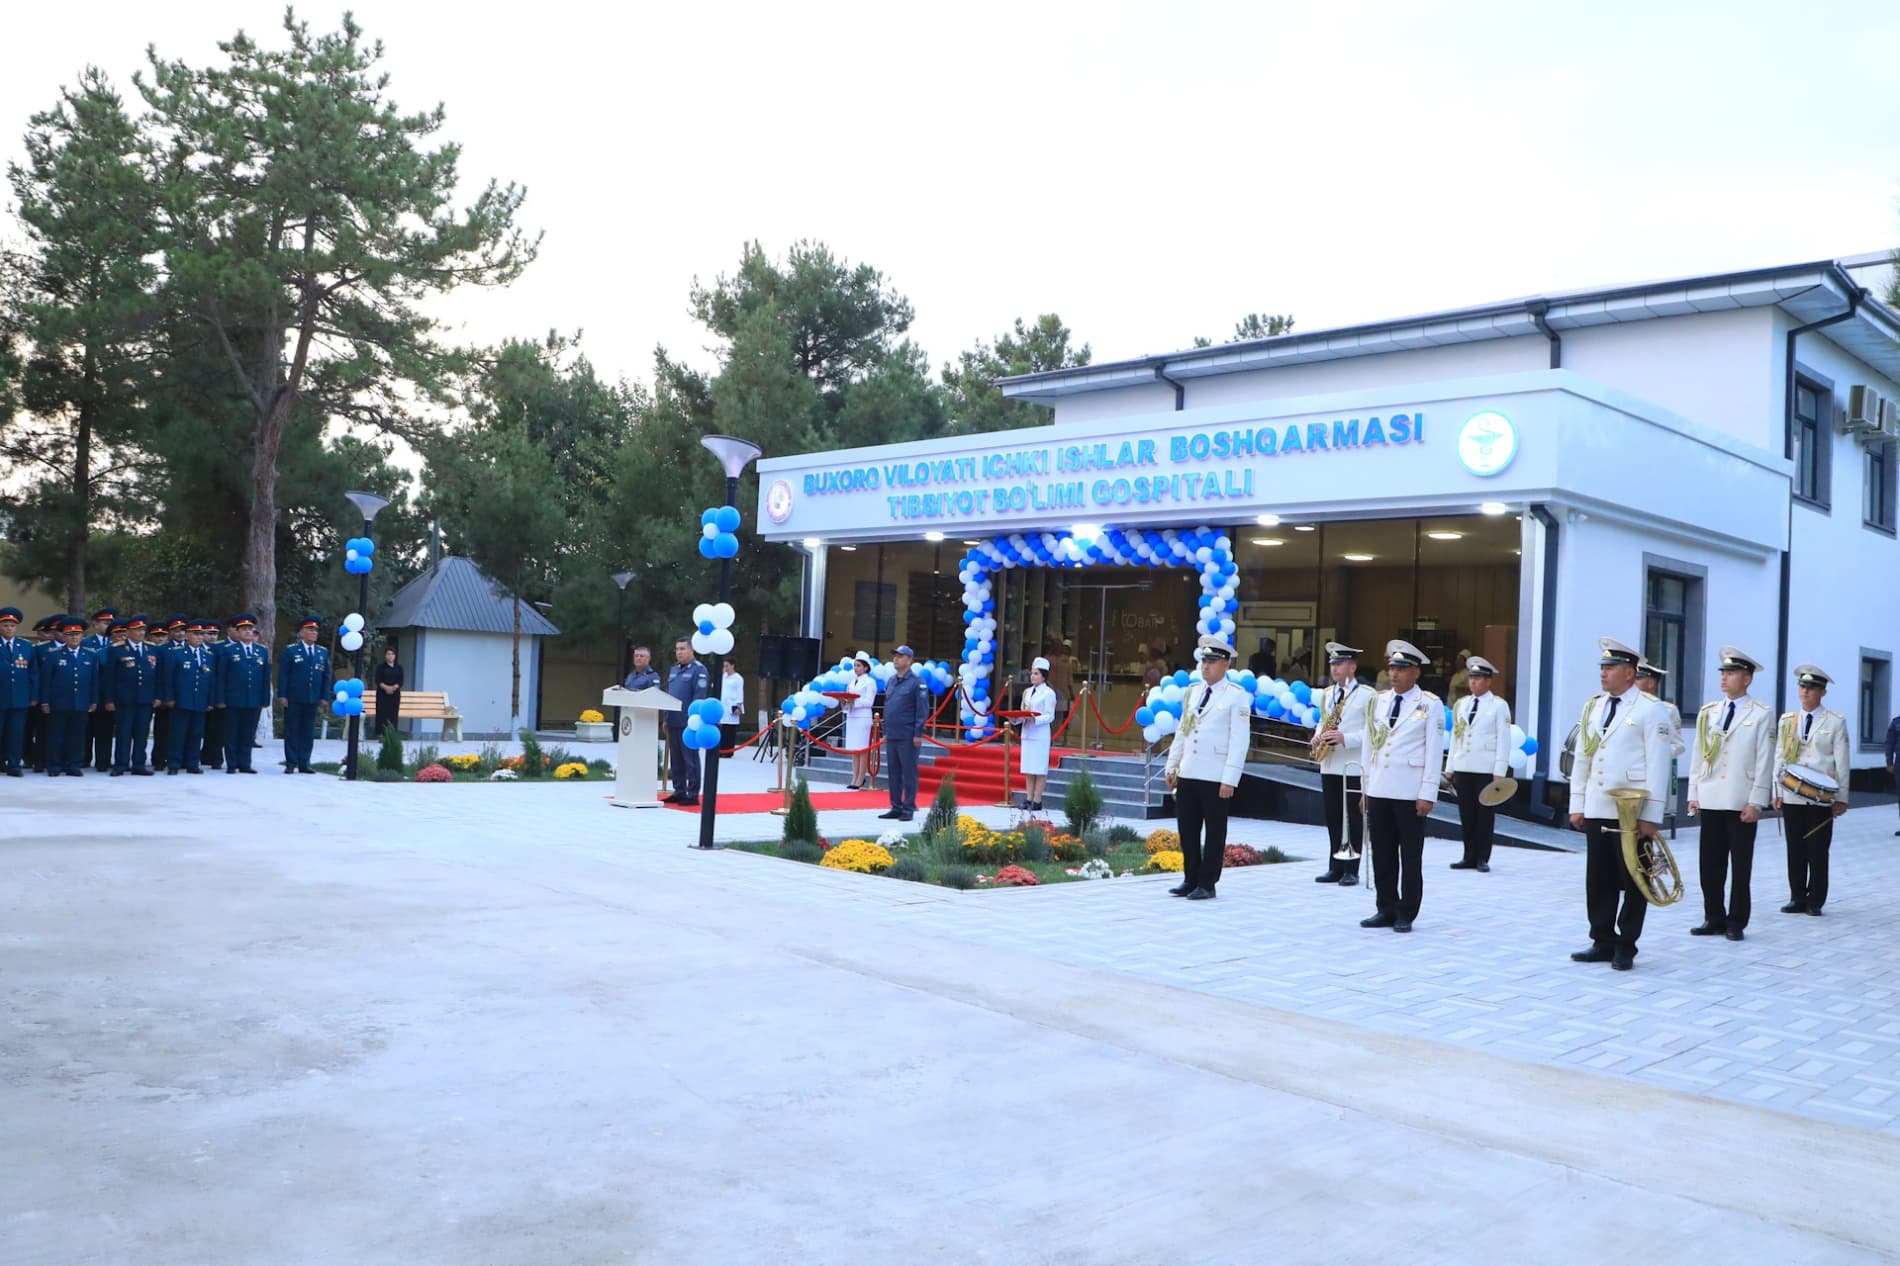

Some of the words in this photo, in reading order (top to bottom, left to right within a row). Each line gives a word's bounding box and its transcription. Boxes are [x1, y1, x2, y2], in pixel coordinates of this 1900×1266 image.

[803, 468, 880, 494] BUXORO
[884, 458, 976, 487] VILOYATI
[982, 449, 1048, 478] ICHKI
[1057, 439, 1156, 472] ISHLAR
[1170, 413, 1423, 461] BOSHQARMASI
[887, 490, 988, 518] TIBBIYOT
[1092, 468, 1252, 505] GOSPITALI
